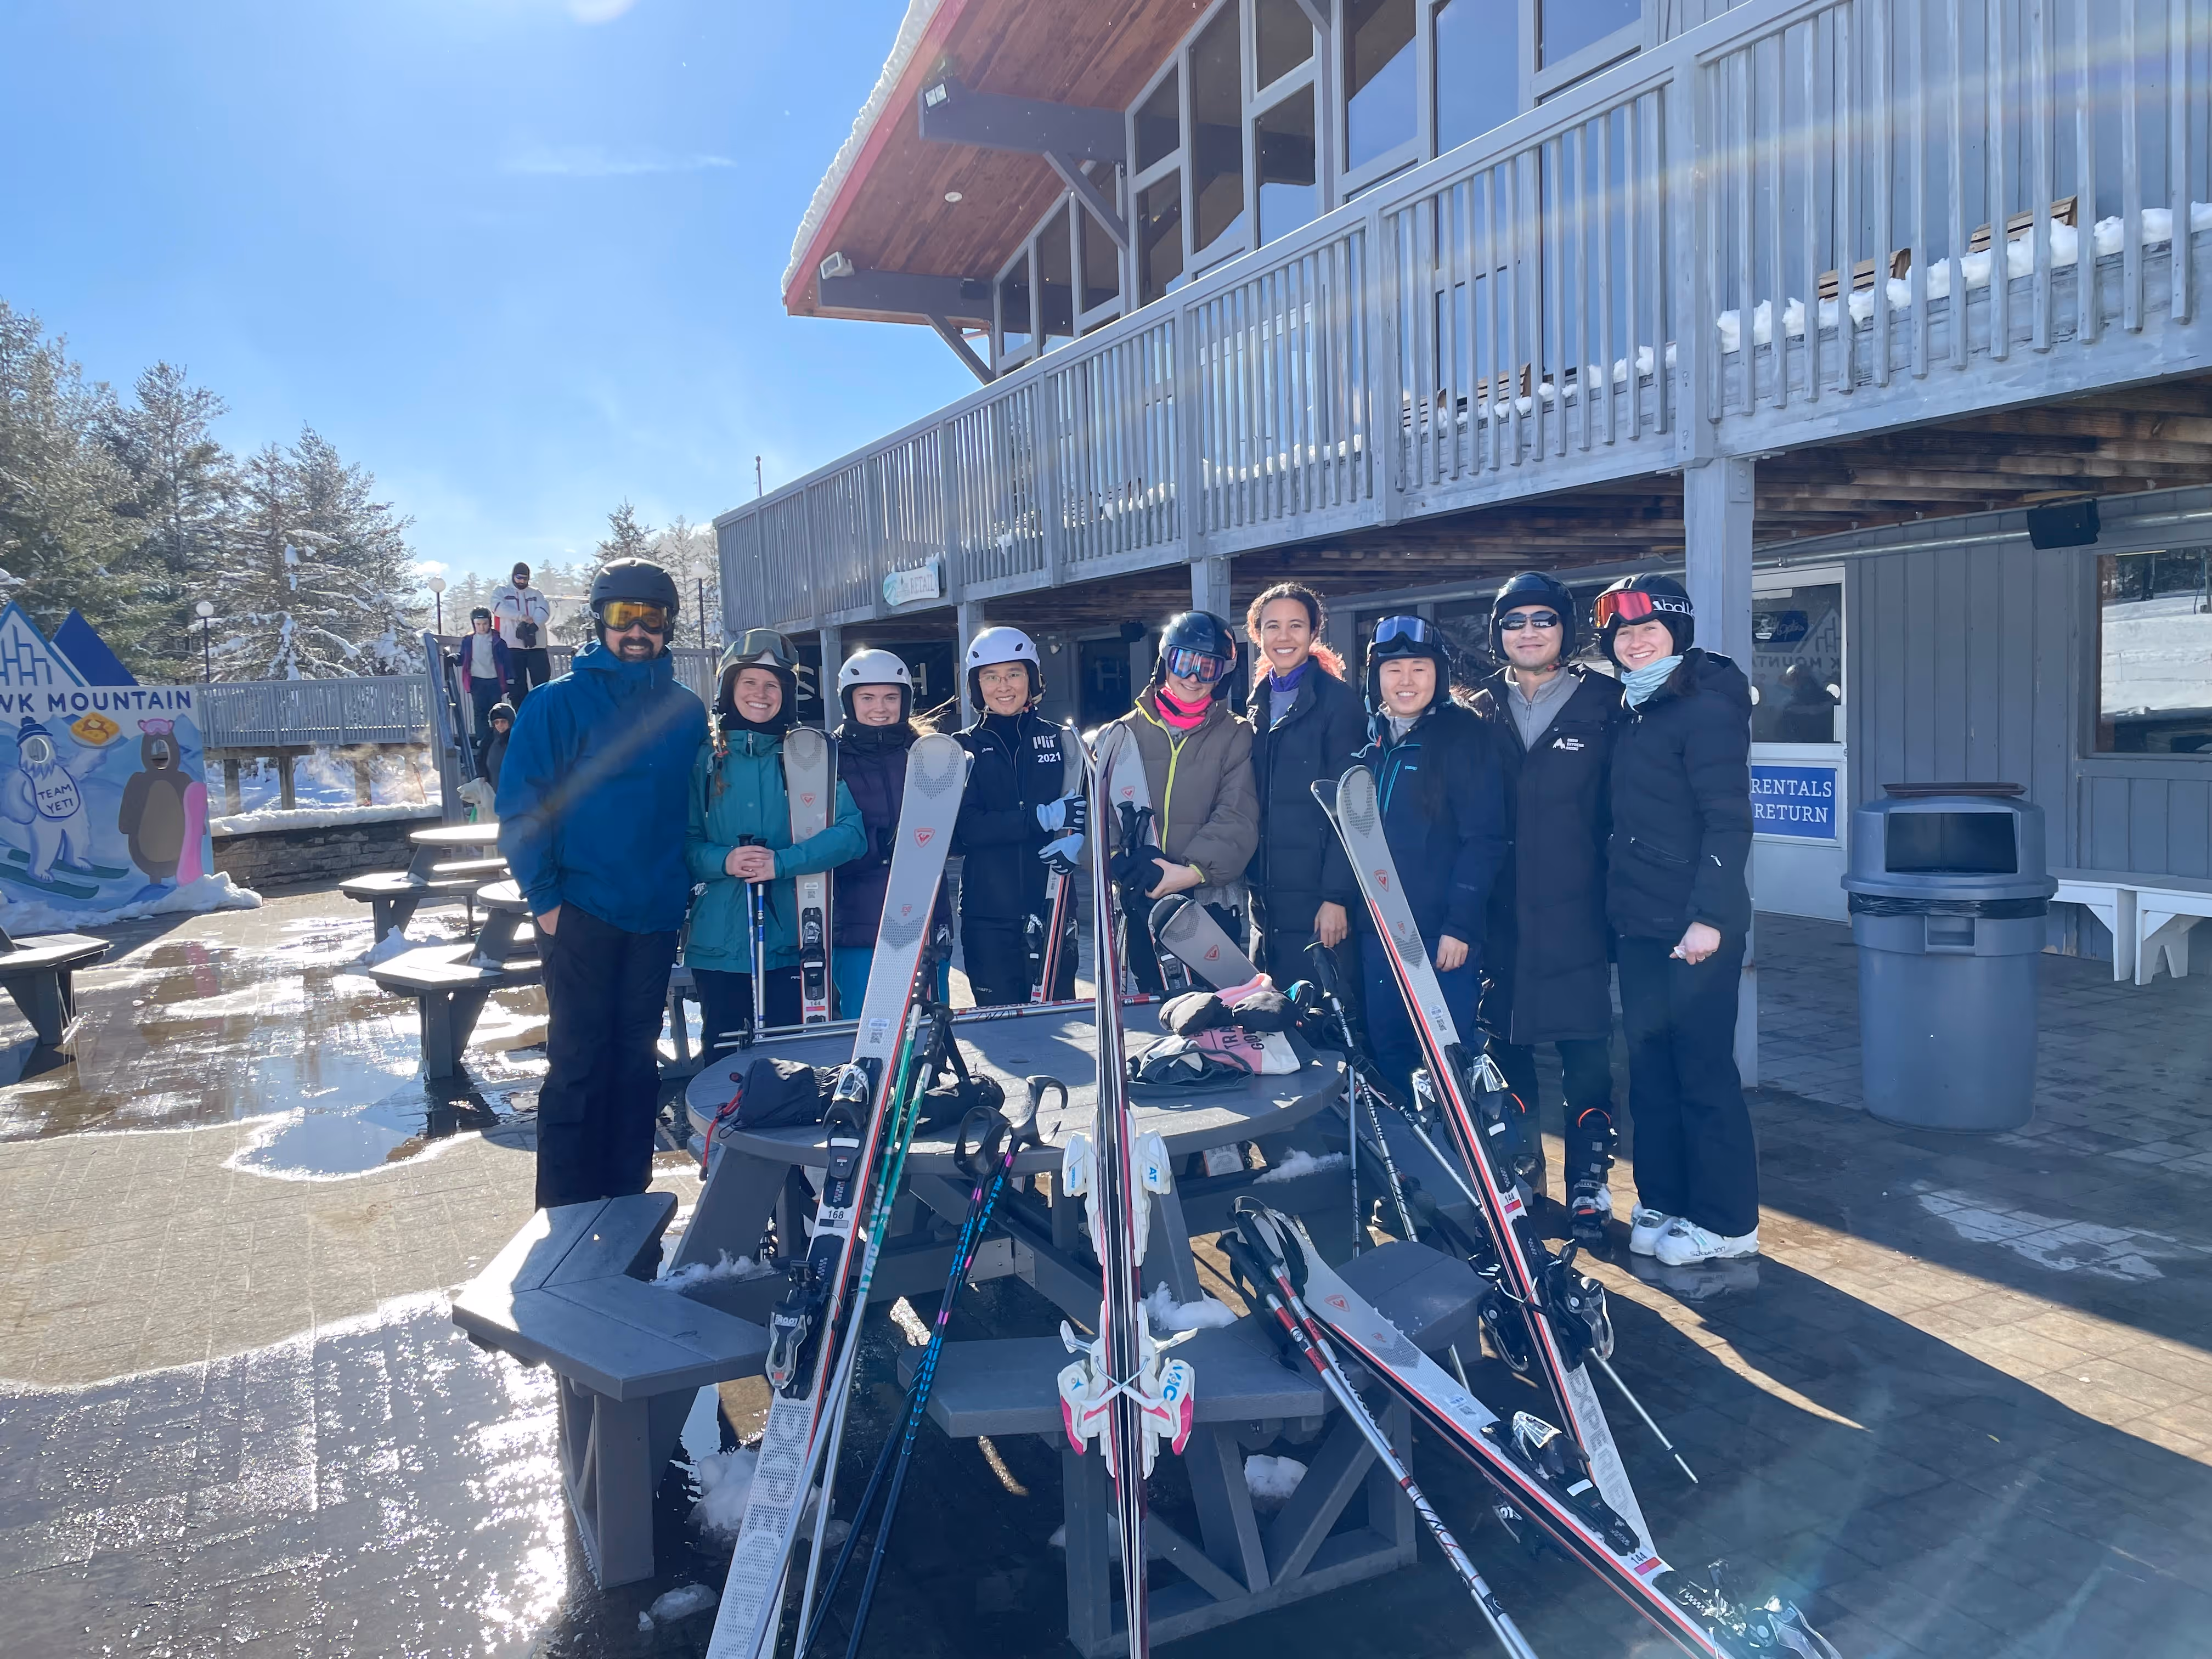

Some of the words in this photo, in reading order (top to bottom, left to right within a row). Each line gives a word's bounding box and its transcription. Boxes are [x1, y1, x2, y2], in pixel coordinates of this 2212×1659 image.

[910, 574, 935, 594] RETAIL
[48, 691, 191, 712] MOUNTAIN
[1037, 752, 1062, 763] 2021
[37, 784, 72, 800] TEAM
[1751, 778, 1832, 798] RENTALS
[46, 798, 74, 814] YETI
[1754, 803, 1828, 823] RETURN
[1505, 1192, 1515, 1204] 144
[827, 1210, 844, 1219] 168
[774, 1314, 798, 1327] LOOK
[1631, 1551, 1648, 1565] 144
